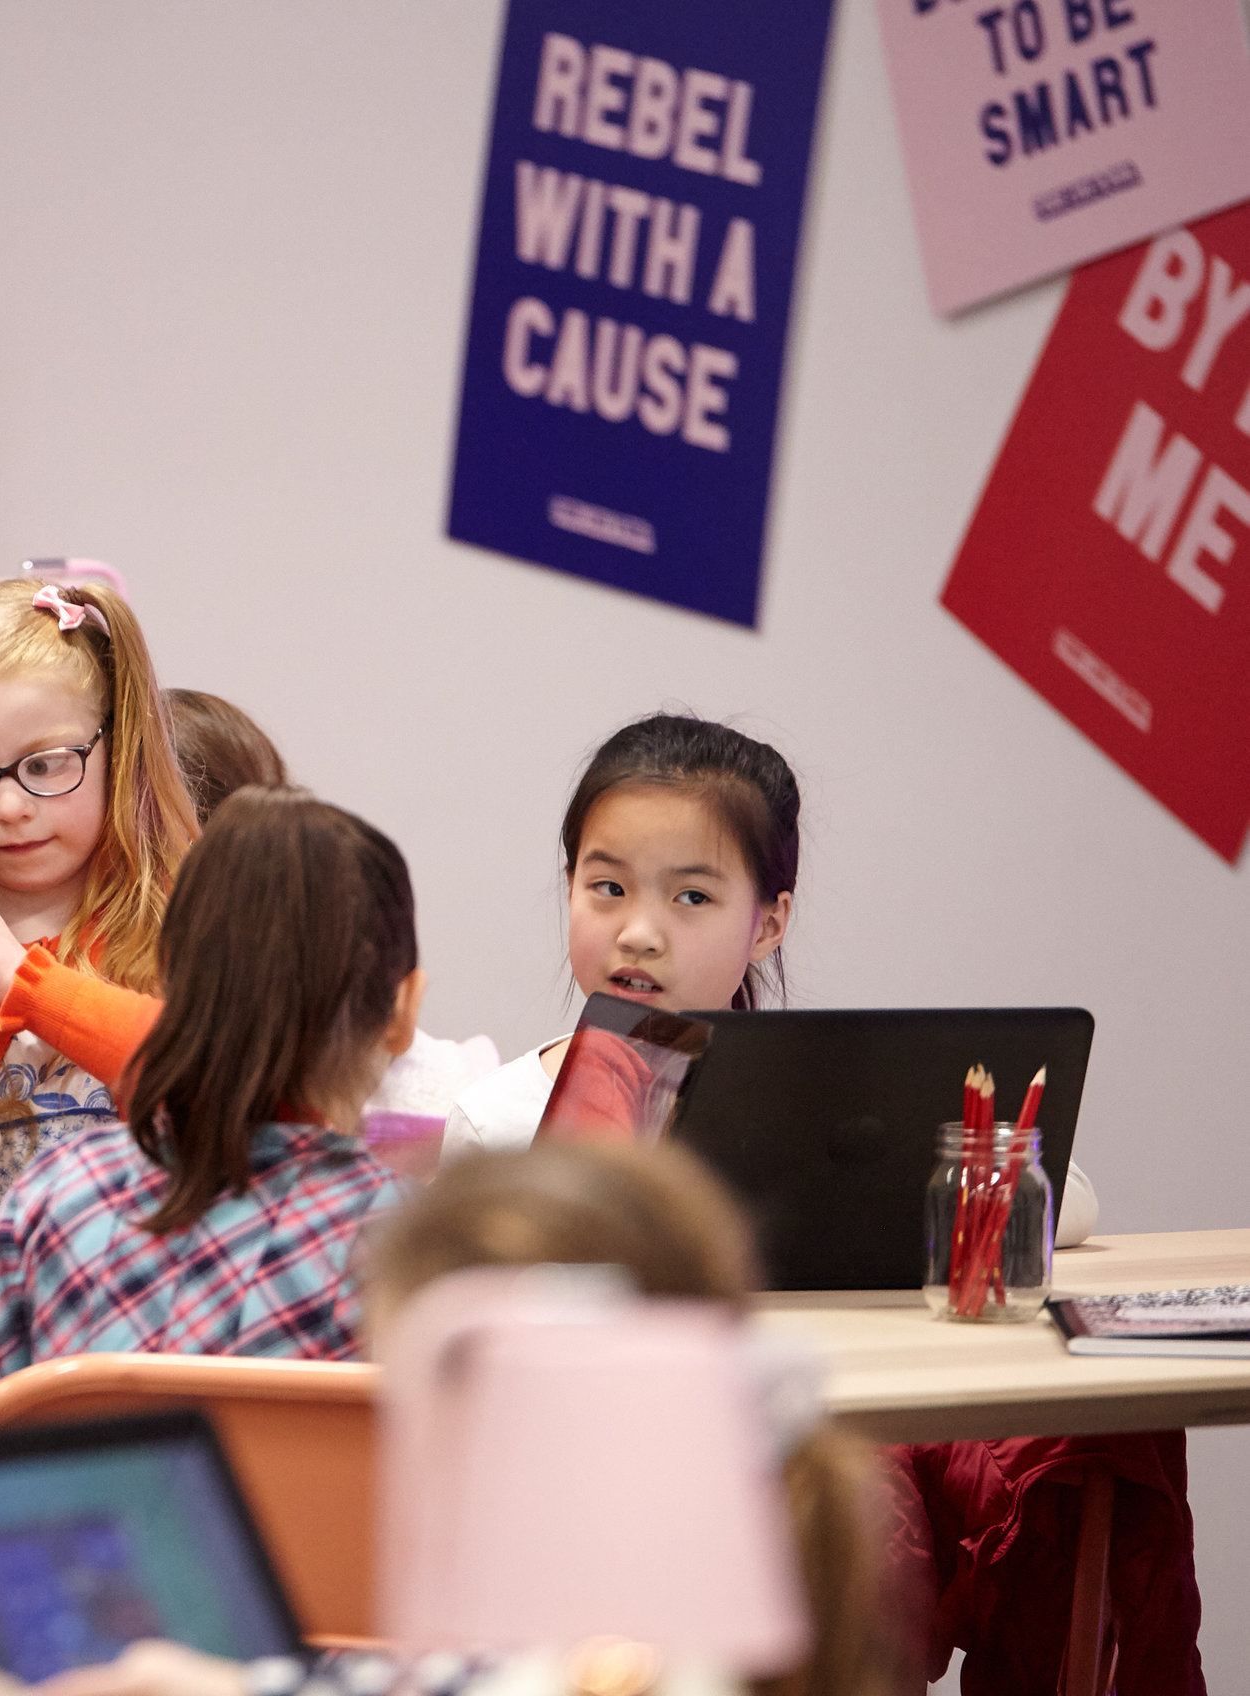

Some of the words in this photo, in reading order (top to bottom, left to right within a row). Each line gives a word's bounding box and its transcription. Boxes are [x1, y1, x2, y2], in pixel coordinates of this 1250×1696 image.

[533, 31, 762, 187] REBEL
[976, 0, 1044, 74] TO
[980, 40, 1155, 168] SMART
[515, 159, 701, 305] WITH
[707, 216, 756, 324] A
[1117, 222, 1250, 392] BY
[503, 296, 738, 453] CAUSE
[1092, 398, 1250, 616] ME
